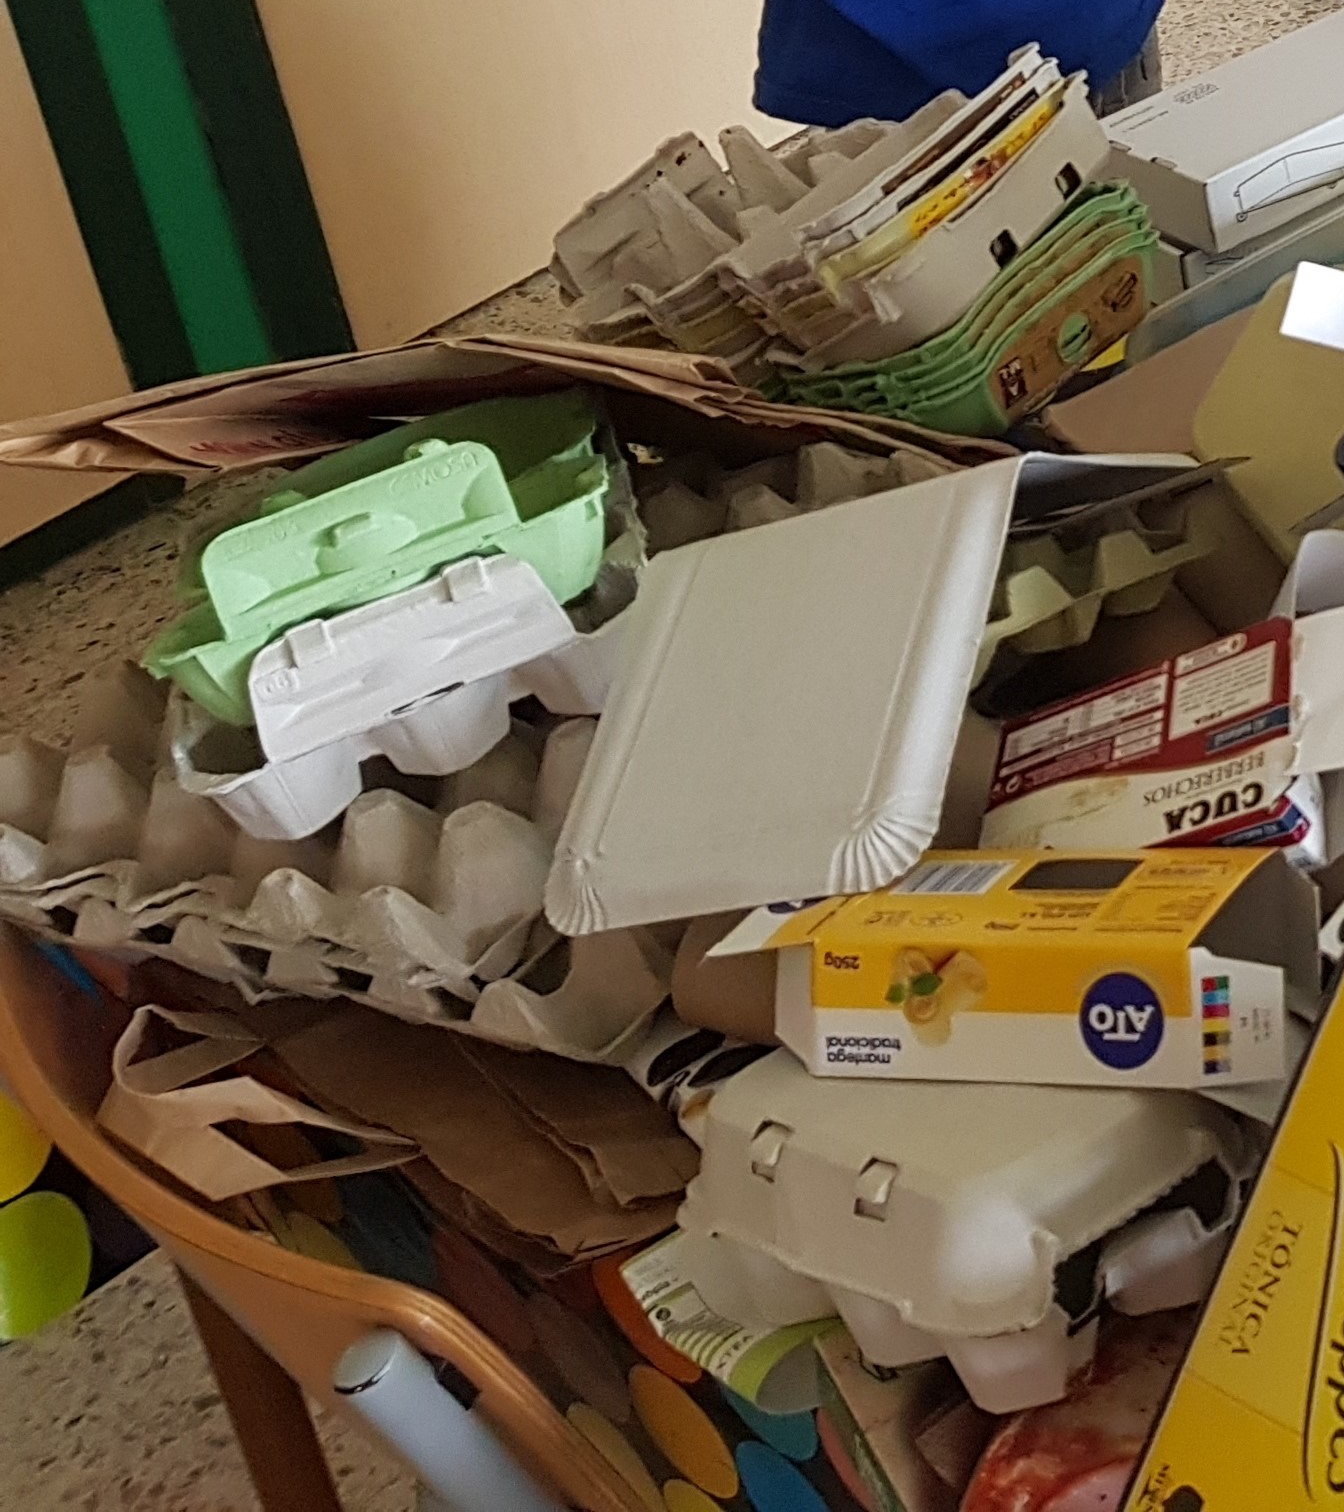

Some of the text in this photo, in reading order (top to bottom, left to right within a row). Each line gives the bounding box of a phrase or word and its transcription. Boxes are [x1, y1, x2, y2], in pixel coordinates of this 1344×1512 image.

[1143, 750, 1267, 808] BERBERECHOS
[1161, 780, 1265, 835] CUCA
[824, 951, 862, 971] 250g
[1087, 1002, 1157, 1045] ATO
[825, 1033, 902, 1052] tradicional
[827, 1050, 893, 1066] mantega
